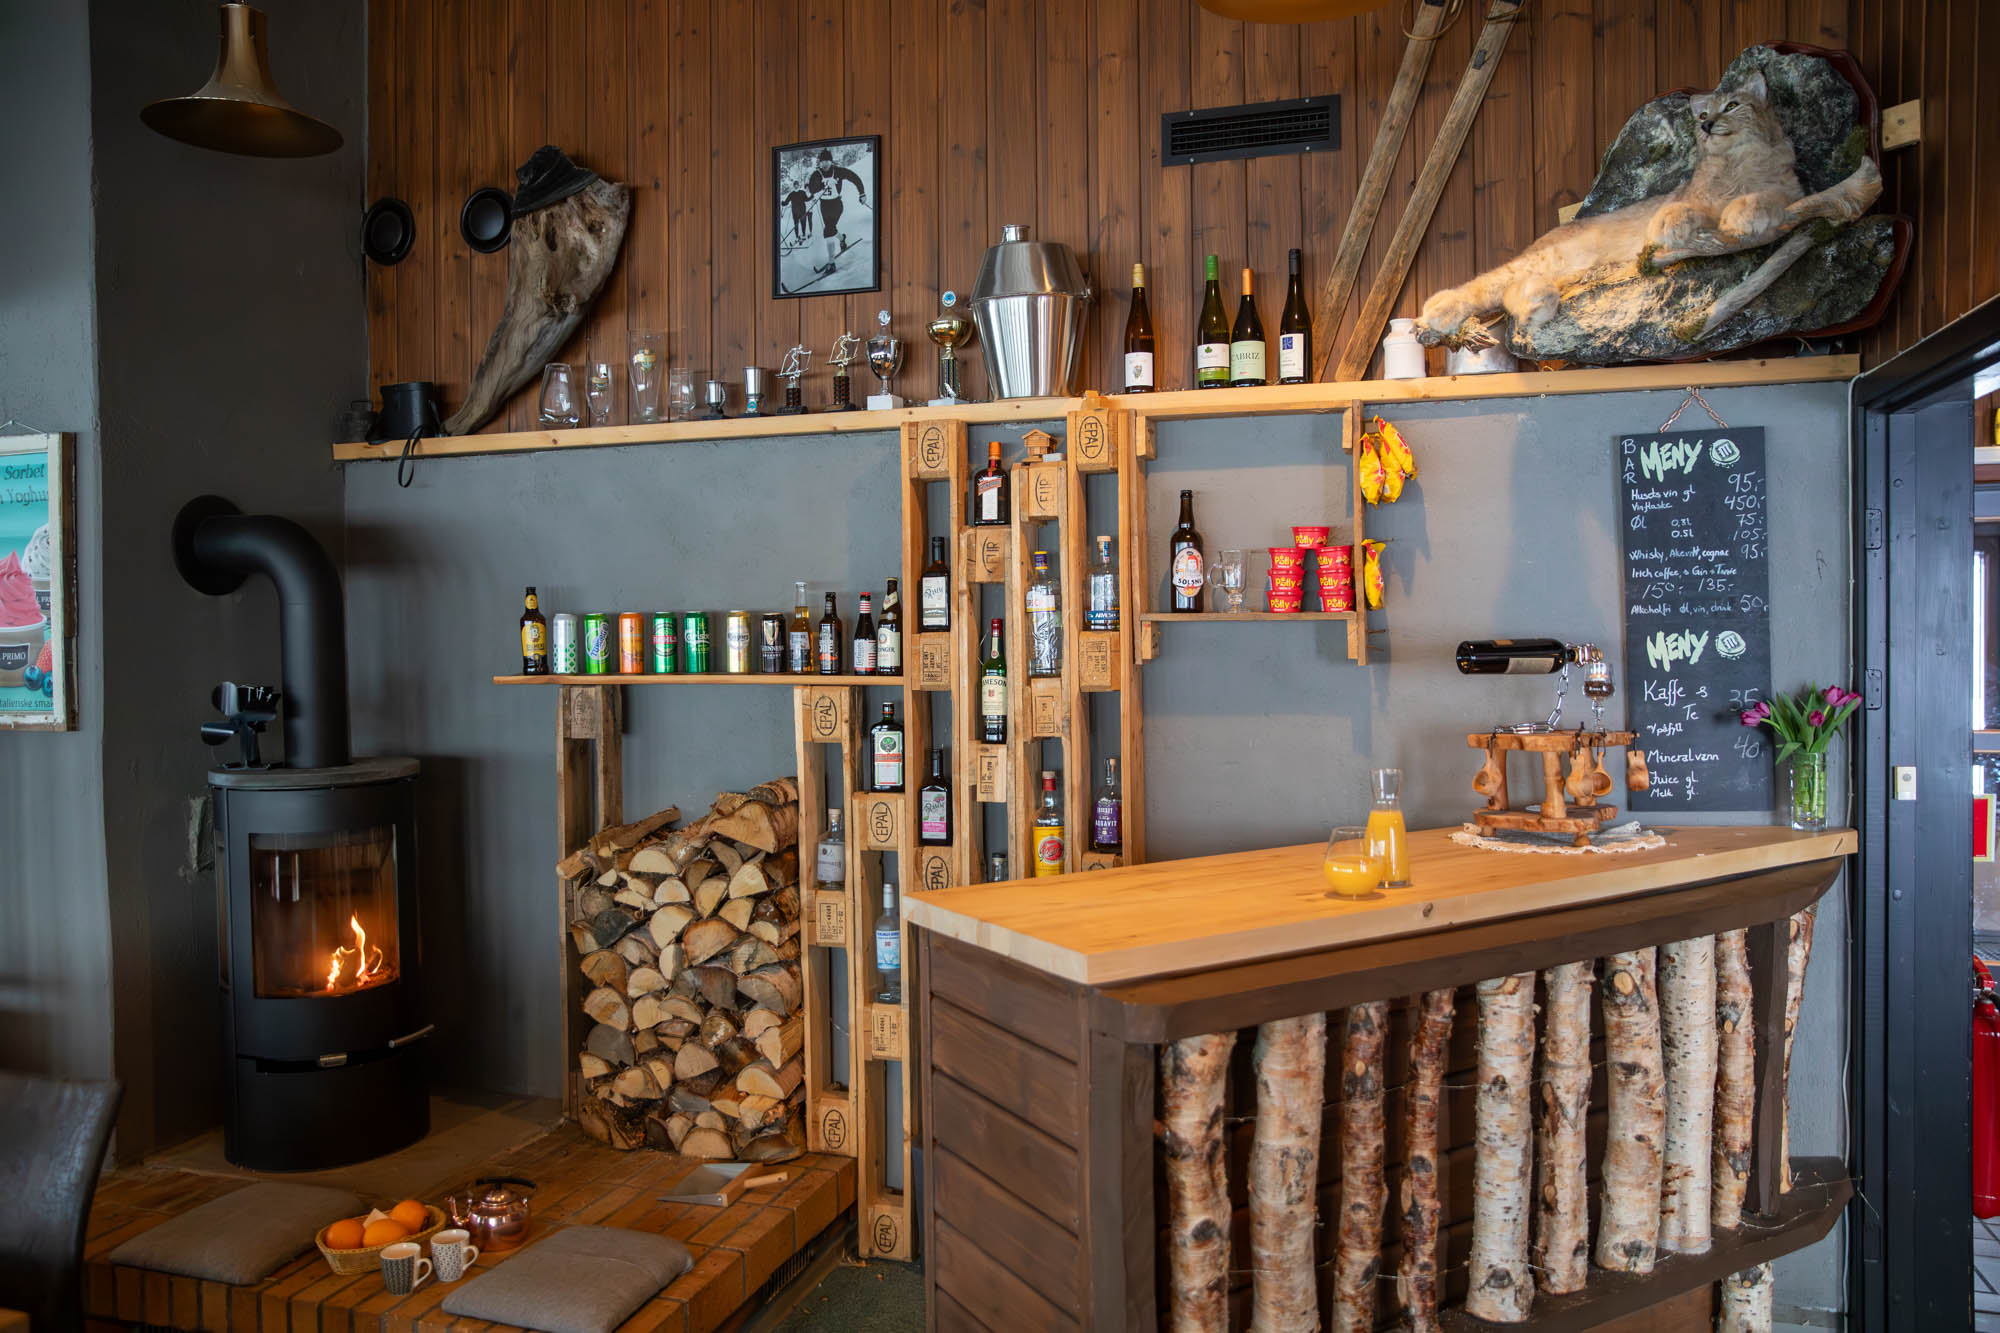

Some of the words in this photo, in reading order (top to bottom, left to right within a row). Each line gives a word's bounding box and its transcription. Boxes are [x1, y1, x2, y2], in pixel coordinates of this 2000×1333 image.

[1085, 421, 1098, 453] EPAL
[926, 433, 941, 463] EPAL
[1641, 438, 1703, 482] MENY
[4, 463, 45, 480] Sorbet
[6, 484, 48, 506] Yoghu
[1274, 555, 1295, 567] Polly
[1691, 565, 1708, 577] Gin
[1275, 577, 1296, 588] Polly
[1270, 598, 1290, 609] Polly
[1326, 598, 1348, 609] Polly
[2, 651, 26, 660] PRIMO
[1646, 628, 1709, 672] MENY
[1644, 678, 1687, 707] Kaffe
[819, 702, 832, 730] EPAL
[1682, 703, 1701, 721] Te
[1647, 748, 1721, 763] Mineralvann
[1649, 771, 1680, 786] Juice
[1650, 787, 1675, 798] Melk
[875, 807, 889, 837] EPAL
[828, 1118, 841, 1143] EPAL
[879, 1223, 892, 1248] EPAL
